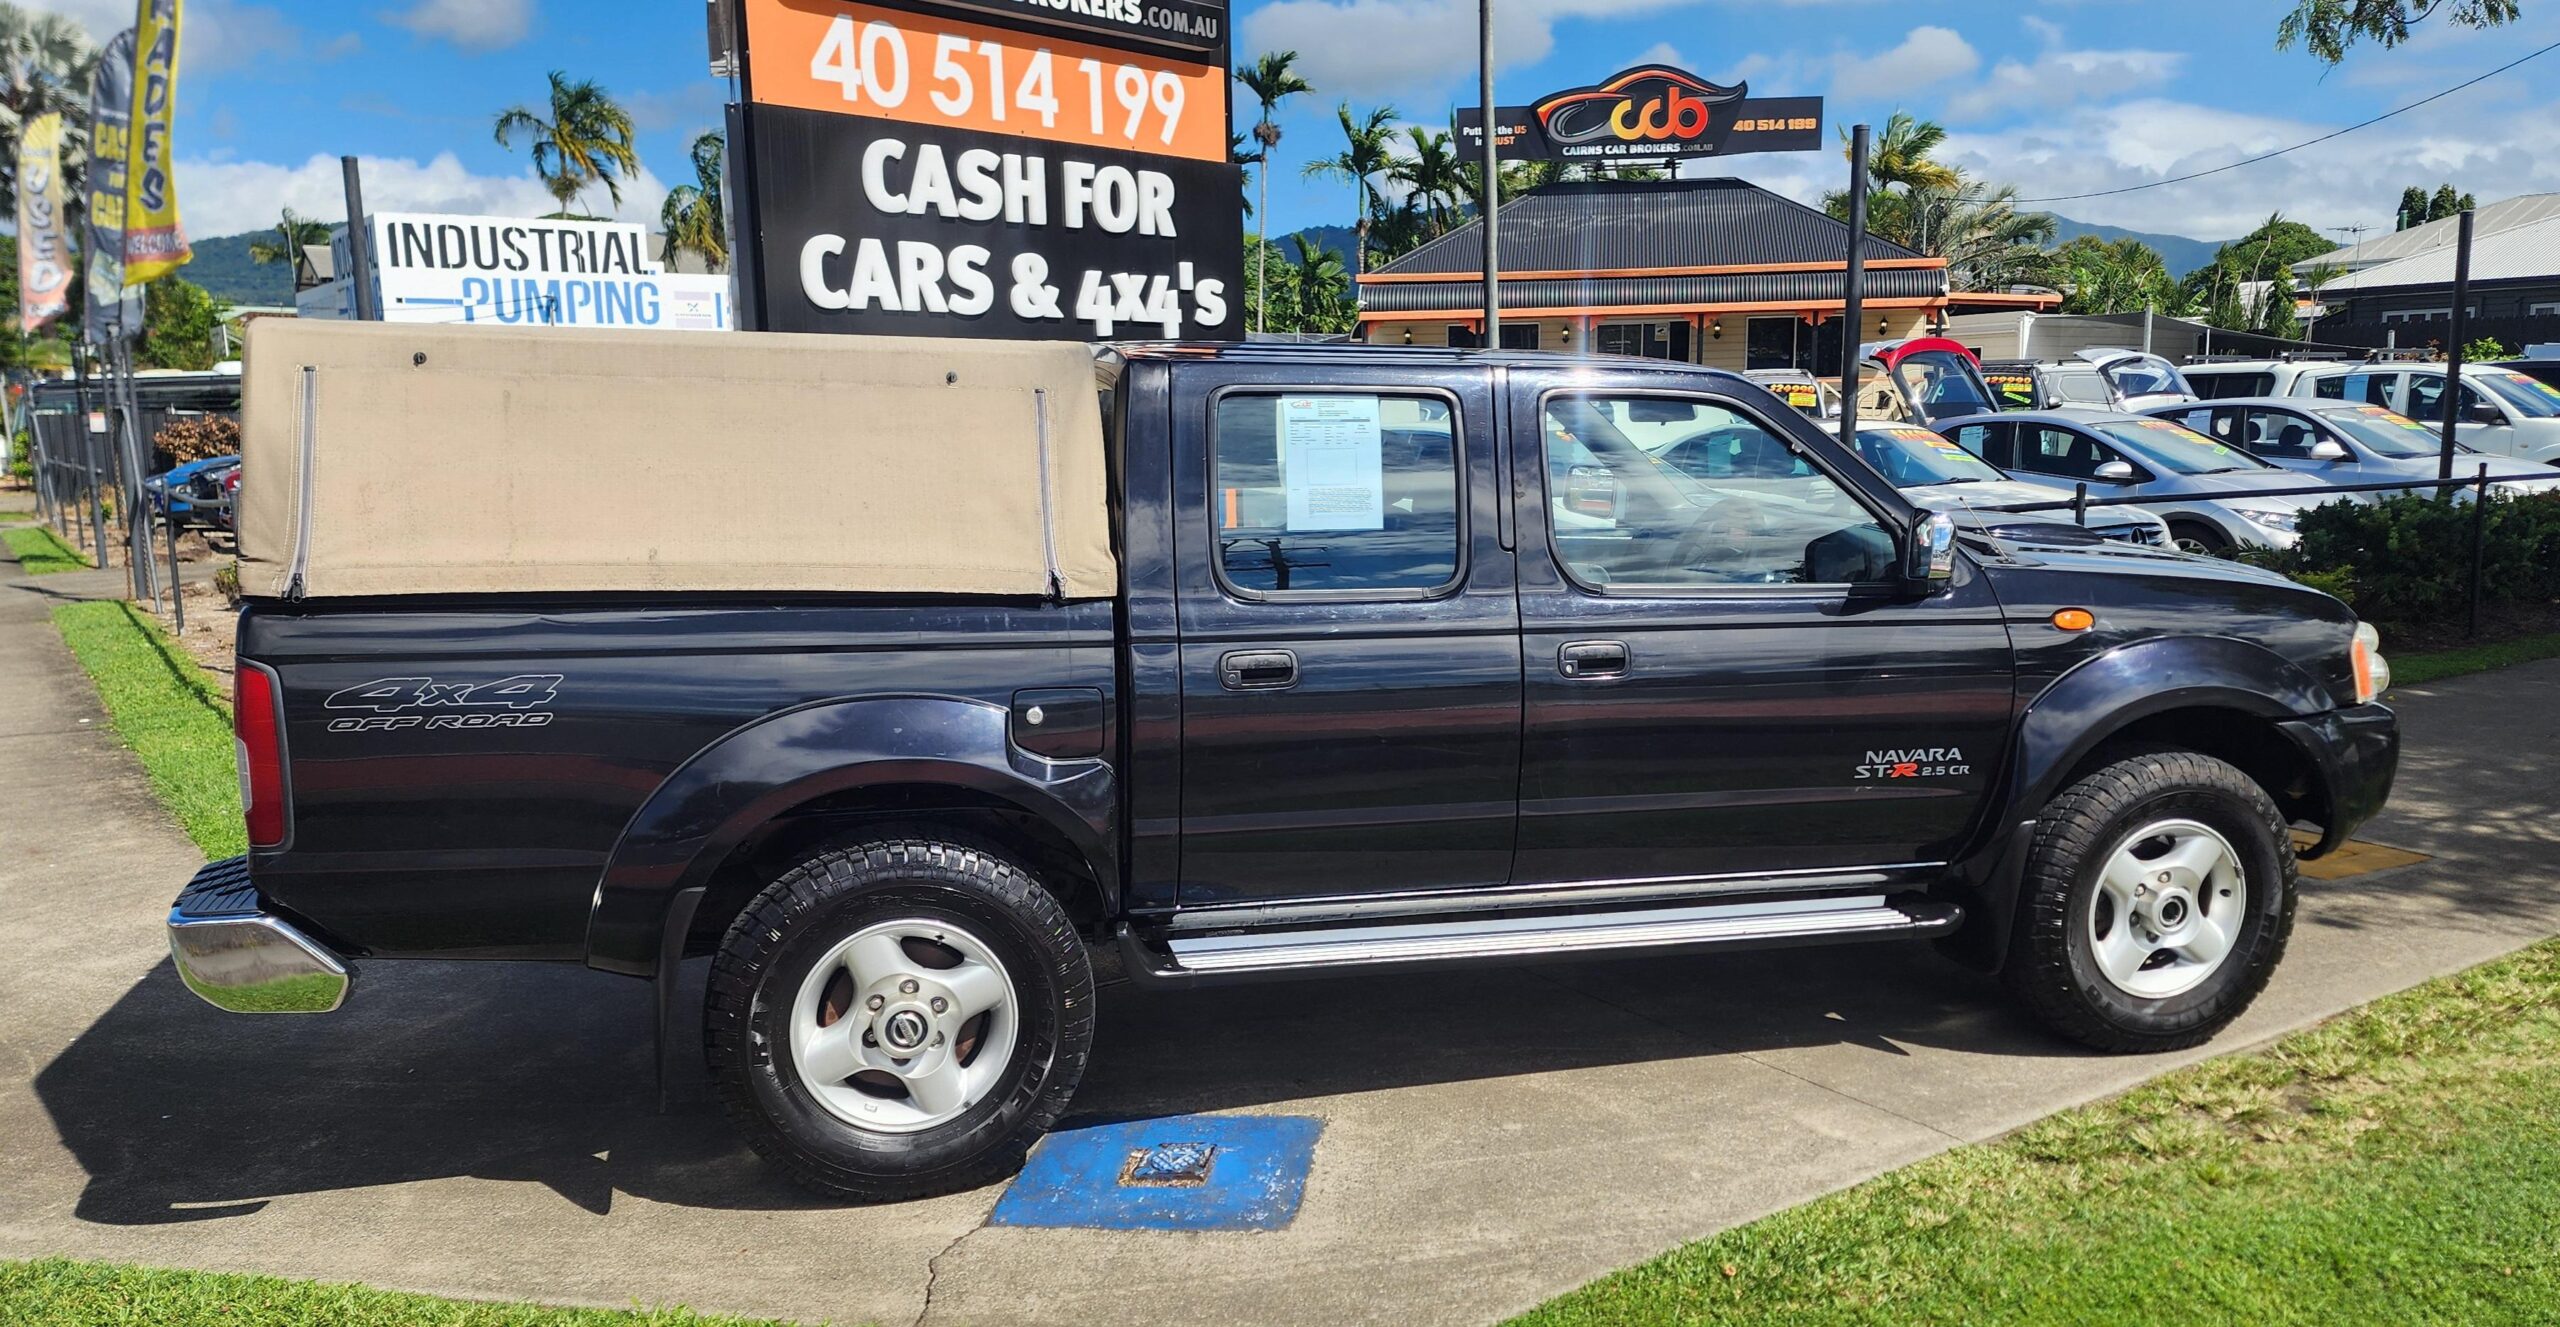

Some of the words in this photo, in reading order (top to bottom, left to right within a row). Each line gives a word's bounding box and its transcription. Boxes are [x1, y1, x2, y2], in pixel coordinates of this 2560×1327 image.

[811, 14, 909, 108] 40
[930, 34, 1059, 128] 514
[1078, 58, 1185, 145] 199
[1463, 126, 1496, 136] Putt
[1497, 125, 1513, 135] the
[1514, 125, 1527, 134] US
[1733, 119, 1755, 132] 40
[1757, 119, 1785, 131] 514
[1788, 118, 1817, 130] 199
[1493, 136, 1515, 146] RUST
[1562, 145, 1603, 156] CAIRNS
[1605, 144, 1627, 155] CAR
[862, 138, 1047, 226] CASH
[1063, 160, 1177, 237] FOR
[25, 163, 63, 293] USED
[387, 221, 650, 275] INDUSTRIAL
[800, 233, 995, 316] CARS
[1010, 252, 1064, 319] &
[462, 276, 661, 325] PUMPING
[324, 673, 565, 713] 4x4
[327, 715, 423, 732] OFF
[425, 712, 553, 730] ROAD
[1854, 762, 1920, 779] ST-R
[1922, 765, 1946, 777] 2.5
[1949, 765, 1970, 775] CR
[1865, 747, 1963, 765] NAVARA
